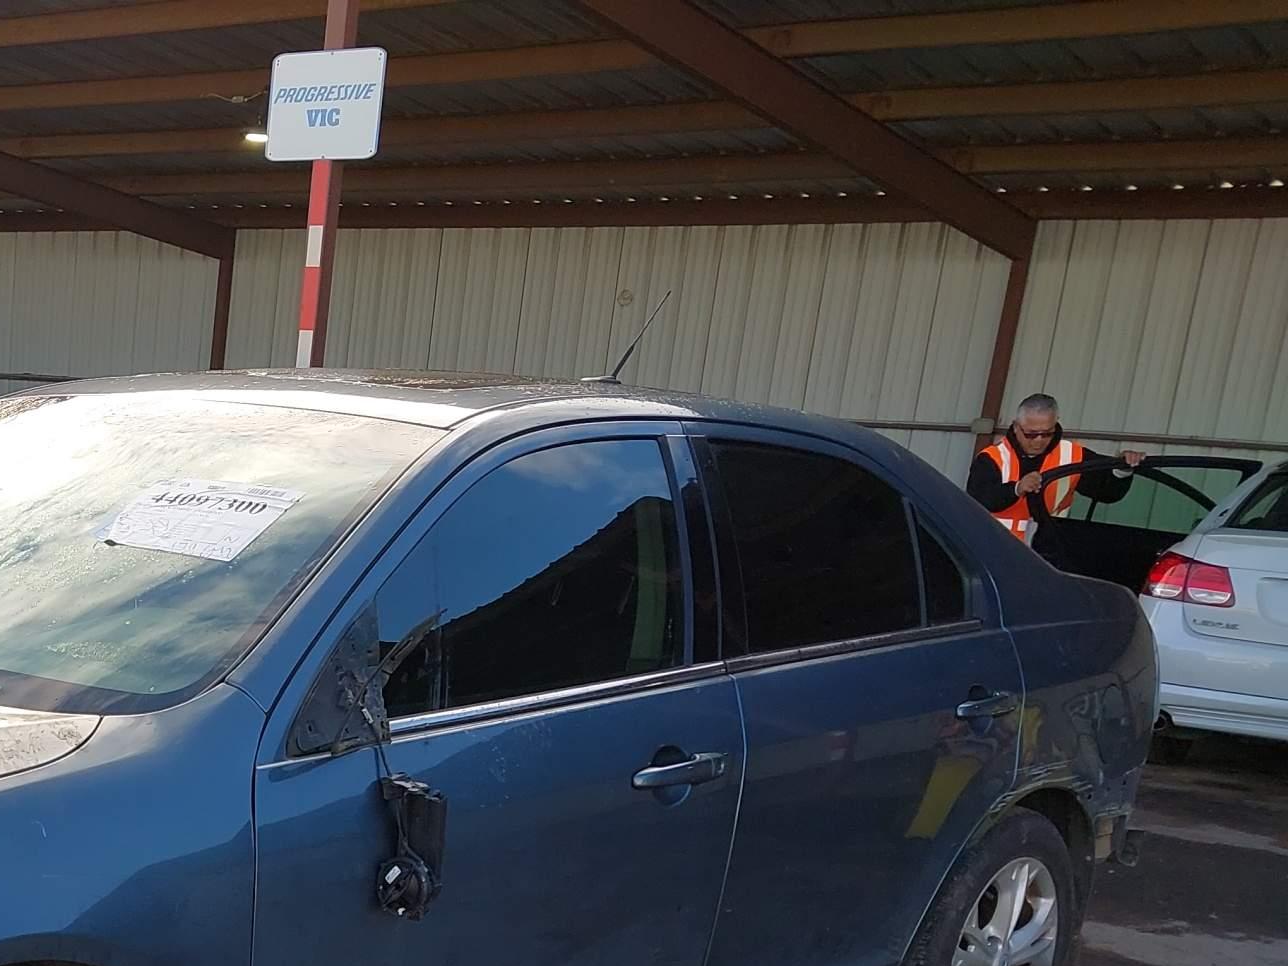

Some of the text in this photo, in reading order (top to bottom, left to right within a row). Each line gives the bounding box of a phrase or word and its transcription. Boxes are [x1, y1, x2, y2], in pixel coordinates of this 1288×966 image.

[273, 82, 377, 105] PROGRESSIVE
[306, 108, 341, 127] VIC
[152, 491, 268, 515] 44097300
